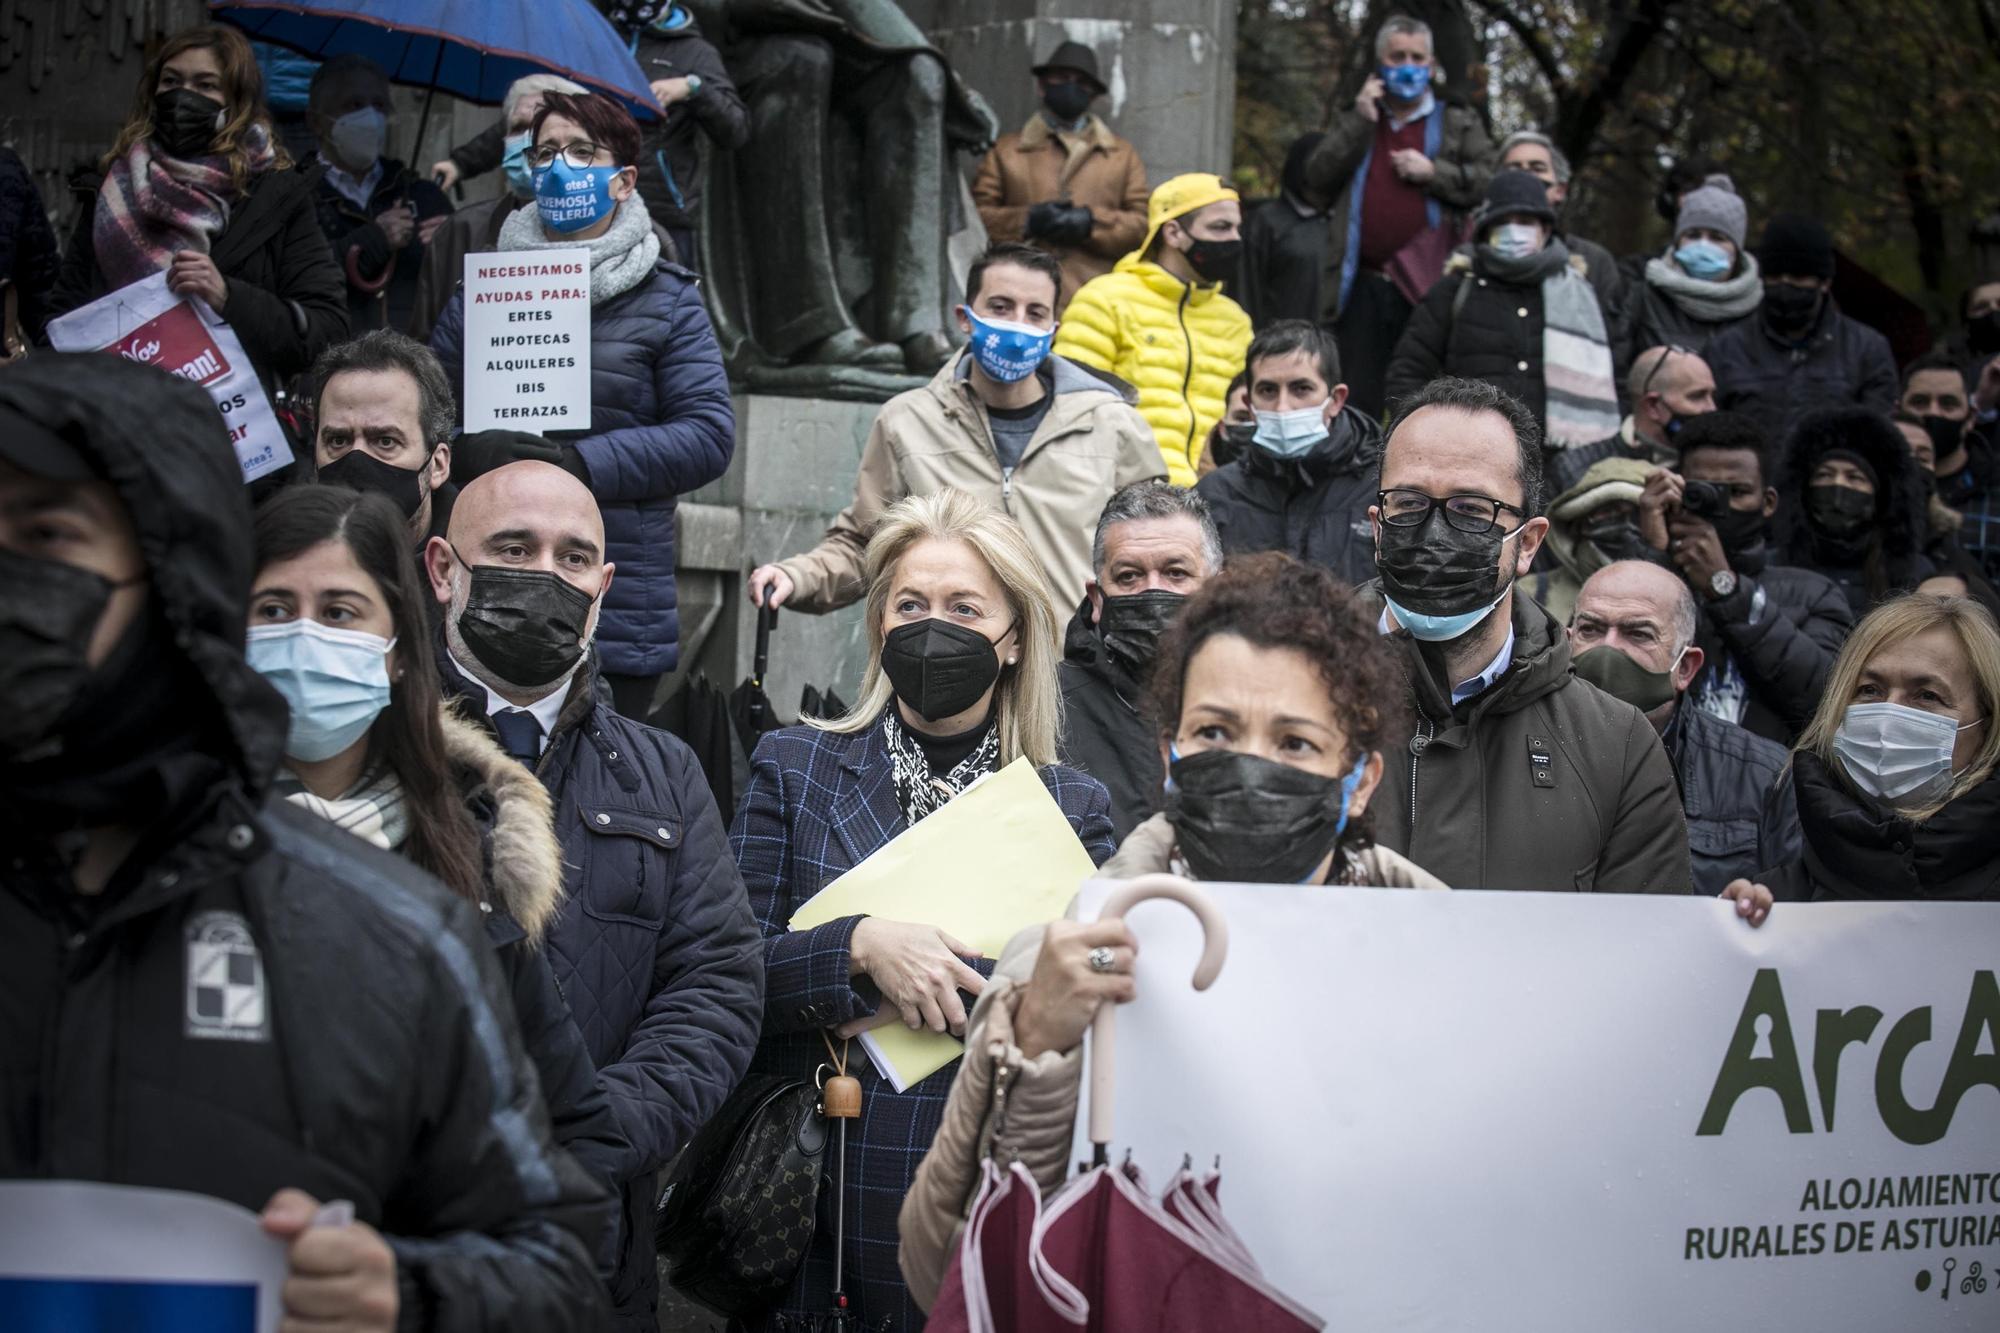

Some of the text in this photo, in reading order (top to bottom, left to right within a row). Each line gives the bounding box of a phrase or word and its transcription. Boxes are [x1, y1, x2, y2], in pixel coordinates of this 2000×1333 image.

[478, 264, 583, 278] NECESITAMOS
[475, 289, 586, 304] AYUDAS PARA:
[508, 311, 552, 322] ERTES
[491, 334, 571, 347] HIPOTECAS
[486, 357, 575, 371] ALQUILERES
[516, 383, 546, 393] IBIS
[493, 406, 568, 418] TERRAZAS
[1684, 1215, 2000, 1260] RURALES DE ASTURIA
